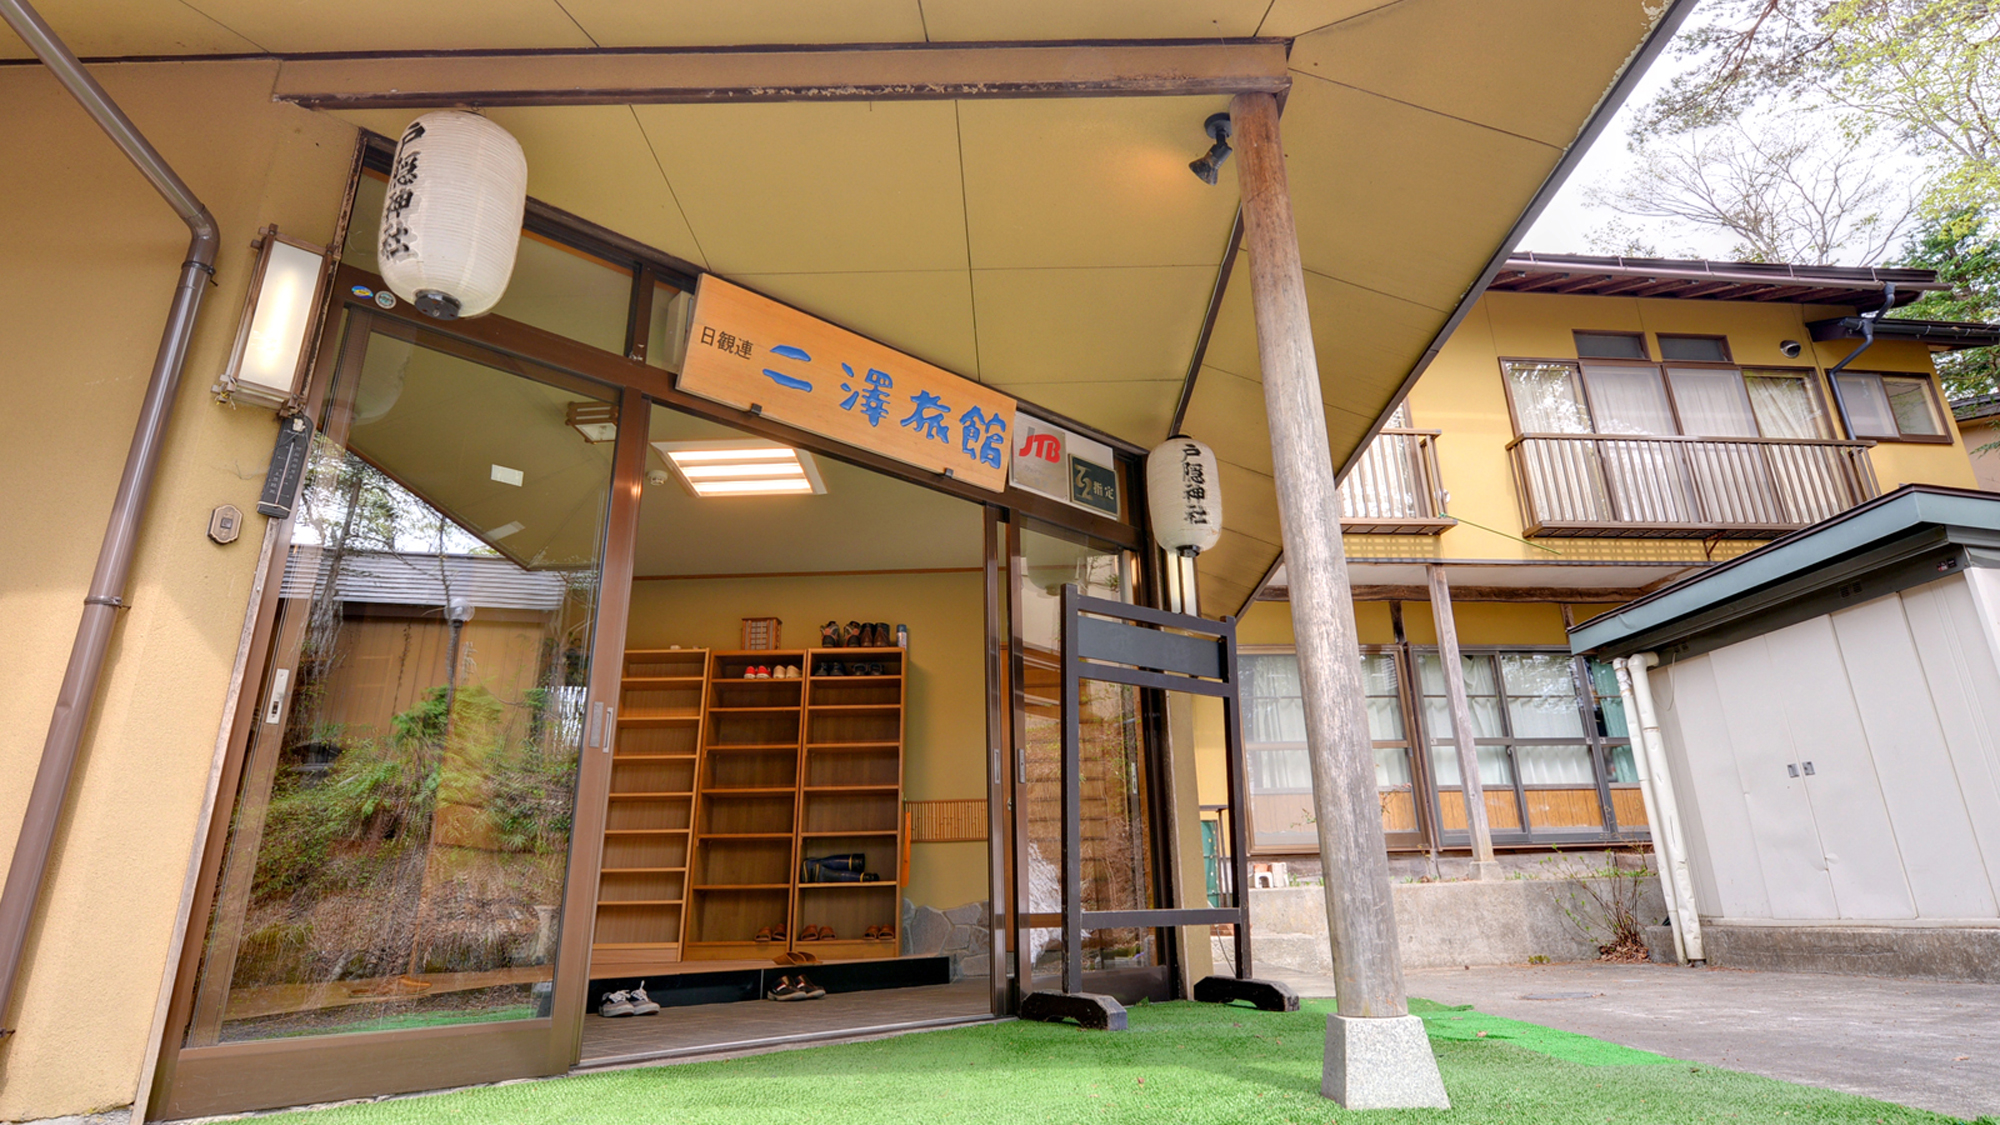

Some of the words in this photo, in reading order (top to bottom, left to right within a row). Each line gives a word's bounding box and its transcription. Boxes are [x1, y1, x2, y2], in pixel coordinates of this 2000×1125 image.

[381, 122, 426, 261] 戸隠神社
[700, 326, 755, 360] 日観連
[762, 344, 1006, 470] 二澤旅館
[1018, 428, 1062, 464] JTB
[1181, 443, 1208, 525] 戸隠神社
